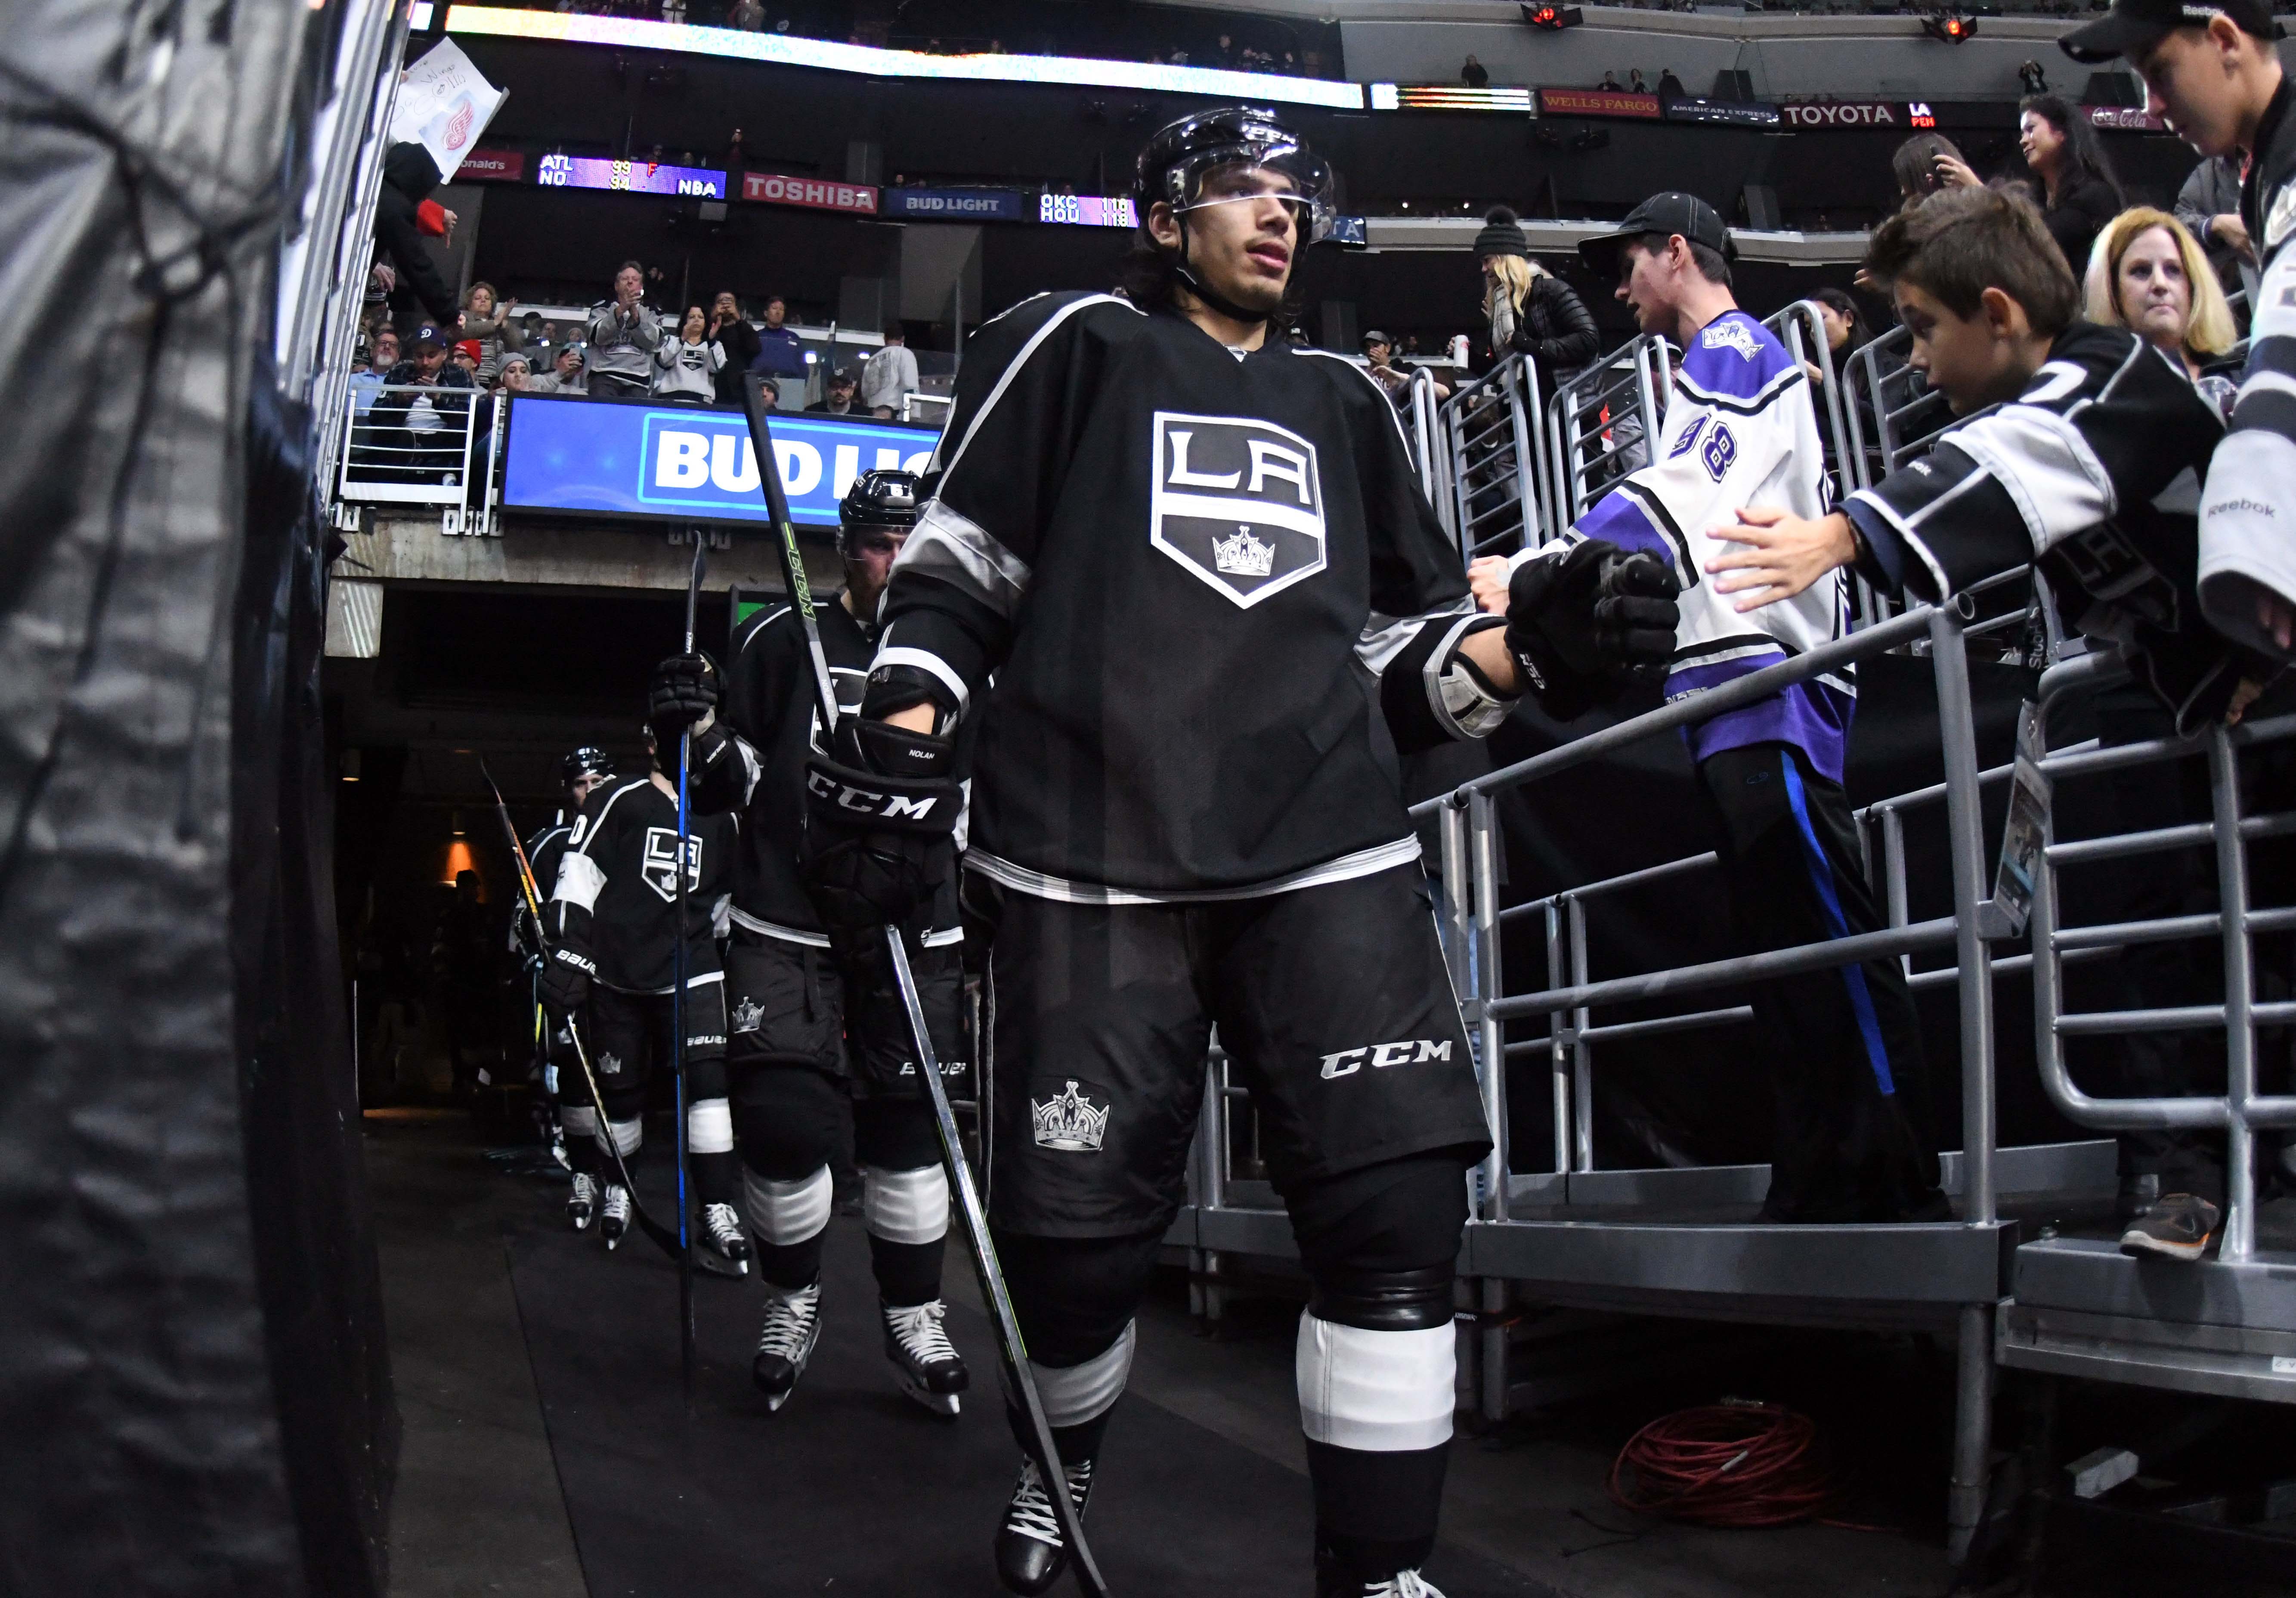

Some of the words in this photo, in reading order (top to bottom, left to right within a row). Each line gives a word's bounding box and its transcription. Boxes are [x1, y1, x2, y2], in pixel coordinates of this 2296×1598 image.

[2183, 5, 2225, 15] Reebo
[1544, 96, 1600, 108] WELLS
[1604, 99, 1657, 111] FARGO
[1672, 105, 1725, 114] AMERICAN
[1728, 109, 1772, 118] EXPRESS
[1909, 103, 1931, 116] LA
[1784, 105, 1894, 124] TOYOTA
[460, 160, 505, 170] onald's
[541, 155, 573, 171] ATL
[611, 160, 632, 175] 99
[539, 170, 566, 186] NO
[610, 176, 631, 190] 94
[678, 179, 716, 195] NBA
[747, 177, 874, 209] TOSHIBA
[1041, 194, 1077, 209] OKC
[906, 198, 944, 210] BUD
[947, 198, 999, 211] LIGHT
[1041, 207, 1080, 223] HOU
[1668, 412, 1737, 484] 98
[656, 430, 822, 496] BUD
[1167, 431, 1311, 505] LA
[2208, 498, 2276, 518] Reebok
[788, 550, 817, 621] CCM
[820, 679, 832, 705] NOLAN
[909, 749, 935, 759] NOLAN
[808, 770, 938, 820] CCM
[1319, 1040, 1453, 1079] CCM
